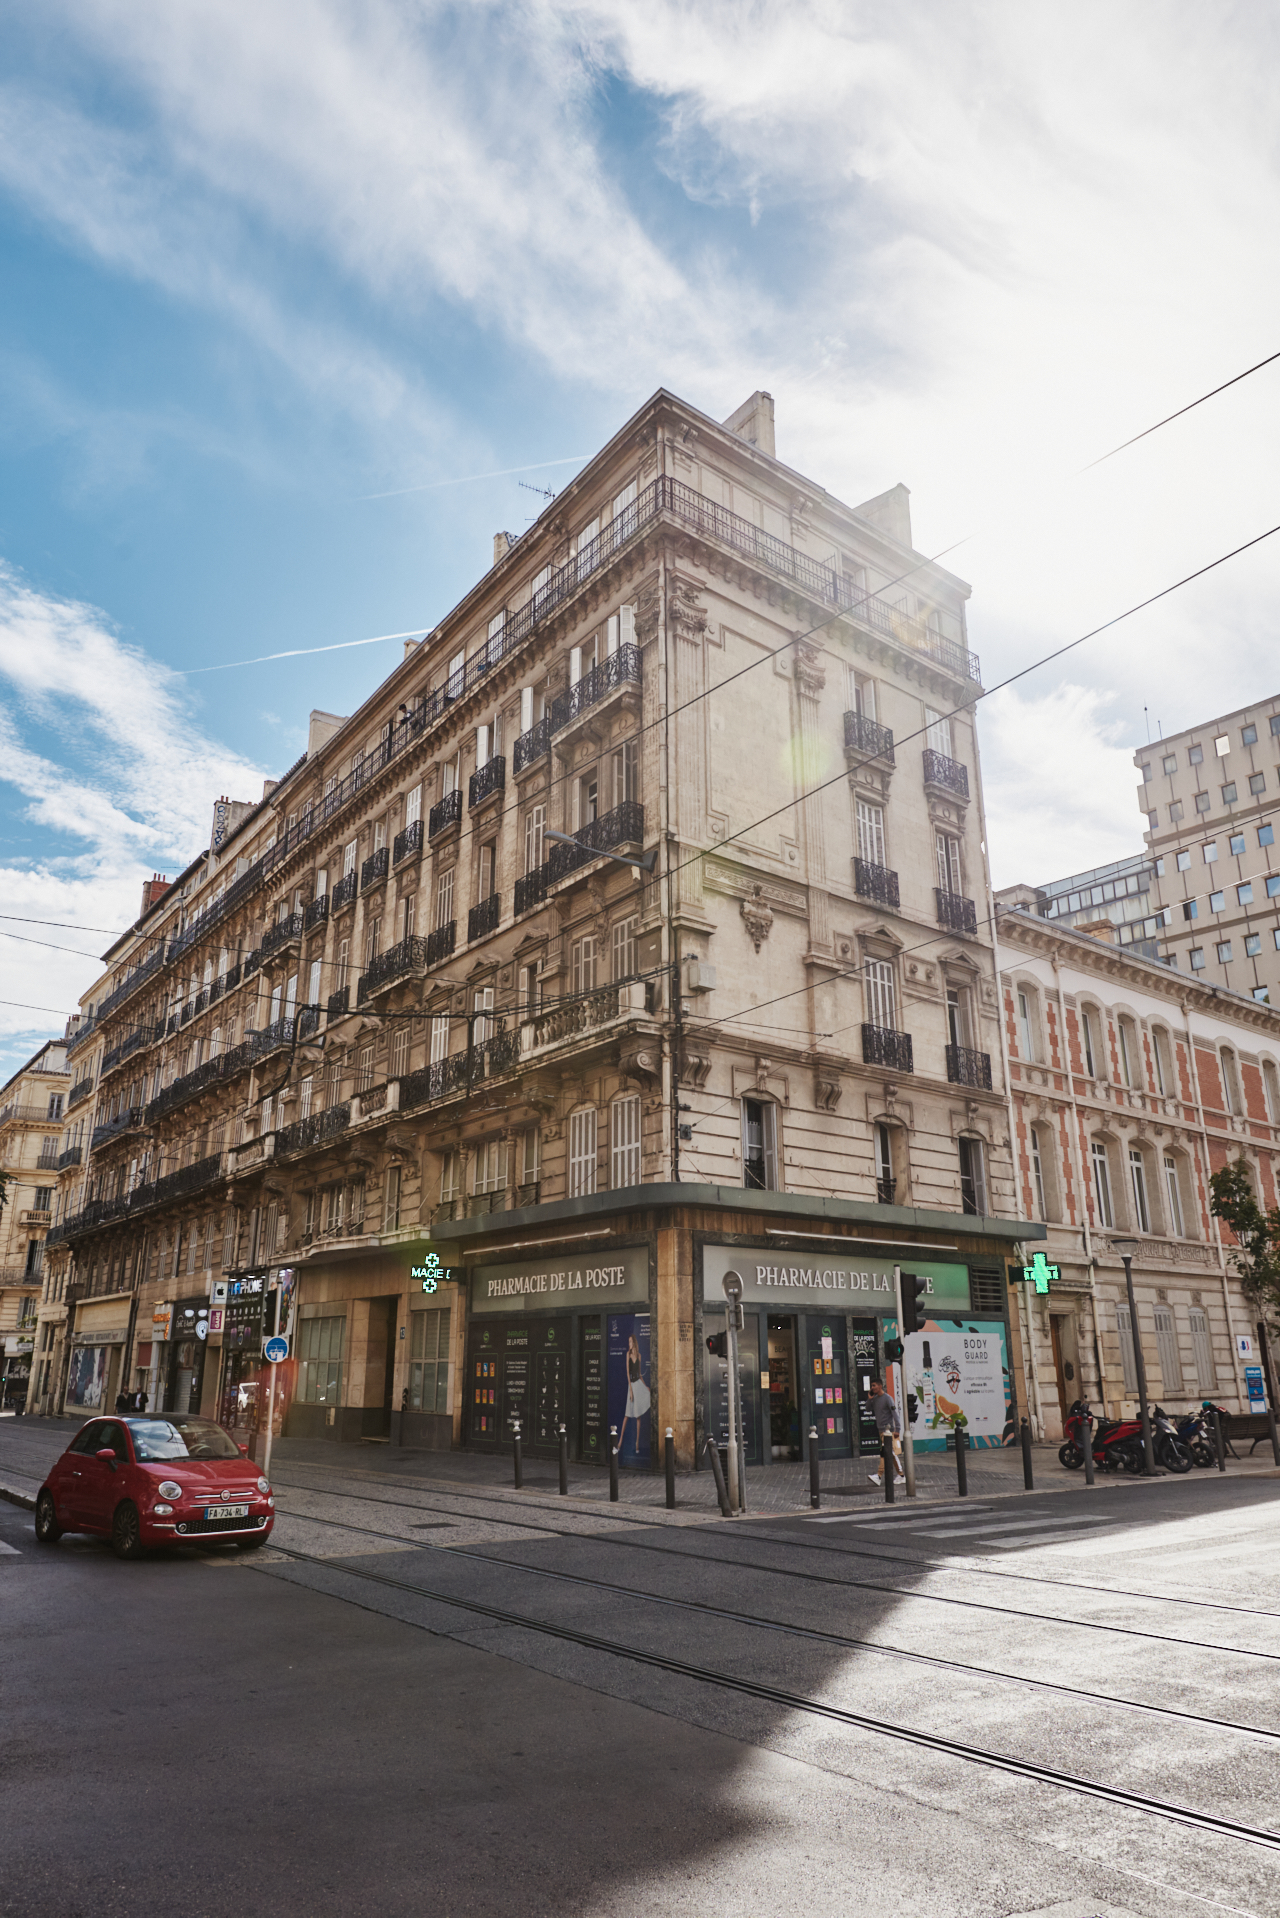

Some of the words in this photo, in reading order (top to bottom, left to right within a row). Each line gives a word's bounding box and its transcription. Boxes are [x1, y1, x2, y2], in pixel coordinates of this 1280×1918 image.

[411, 1267, 444, 1279] MACIE
[487, 1272, 548, 1297] PHARMACIE
[550, 1272, 566, 1292] DE
[568, 1270, 583, 1291] LA
[585, 1266, 625, 1288] POSTE
[755, 1265, 846, 1290] PHARMACIE
[849, 1272, 870, 1291] DE
[872, 1273, 890, 1292] LA
[964, 1339, 987, 1348] BODY
